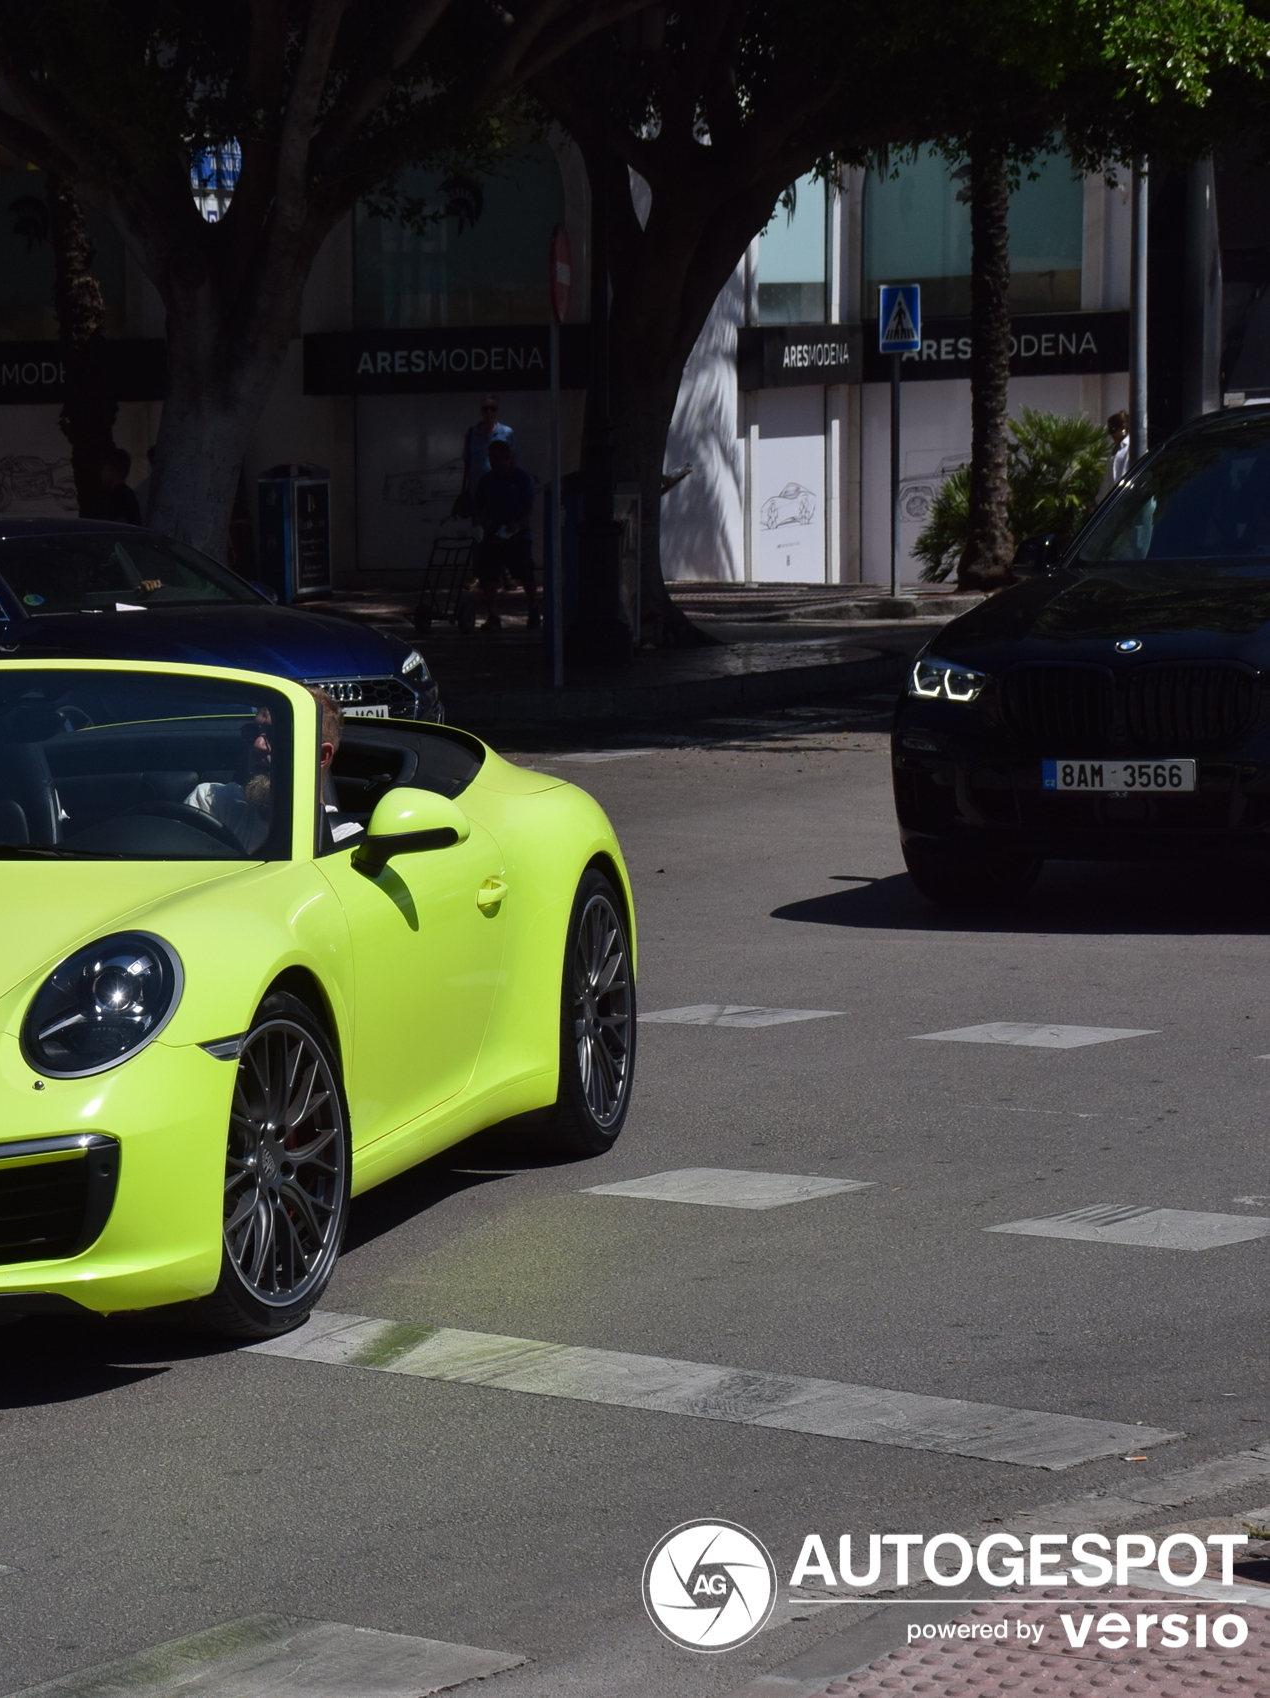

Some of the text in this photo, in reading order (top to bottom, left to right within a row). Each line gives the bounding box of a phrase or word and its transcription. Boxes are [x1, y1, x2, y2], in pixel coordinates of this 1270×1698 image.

[356, 346, 545, 374] ARESMODENA
[783, 343, 849, 368] ARESMODENA
[1061, 764, 1182, 788] 8AM 3566
